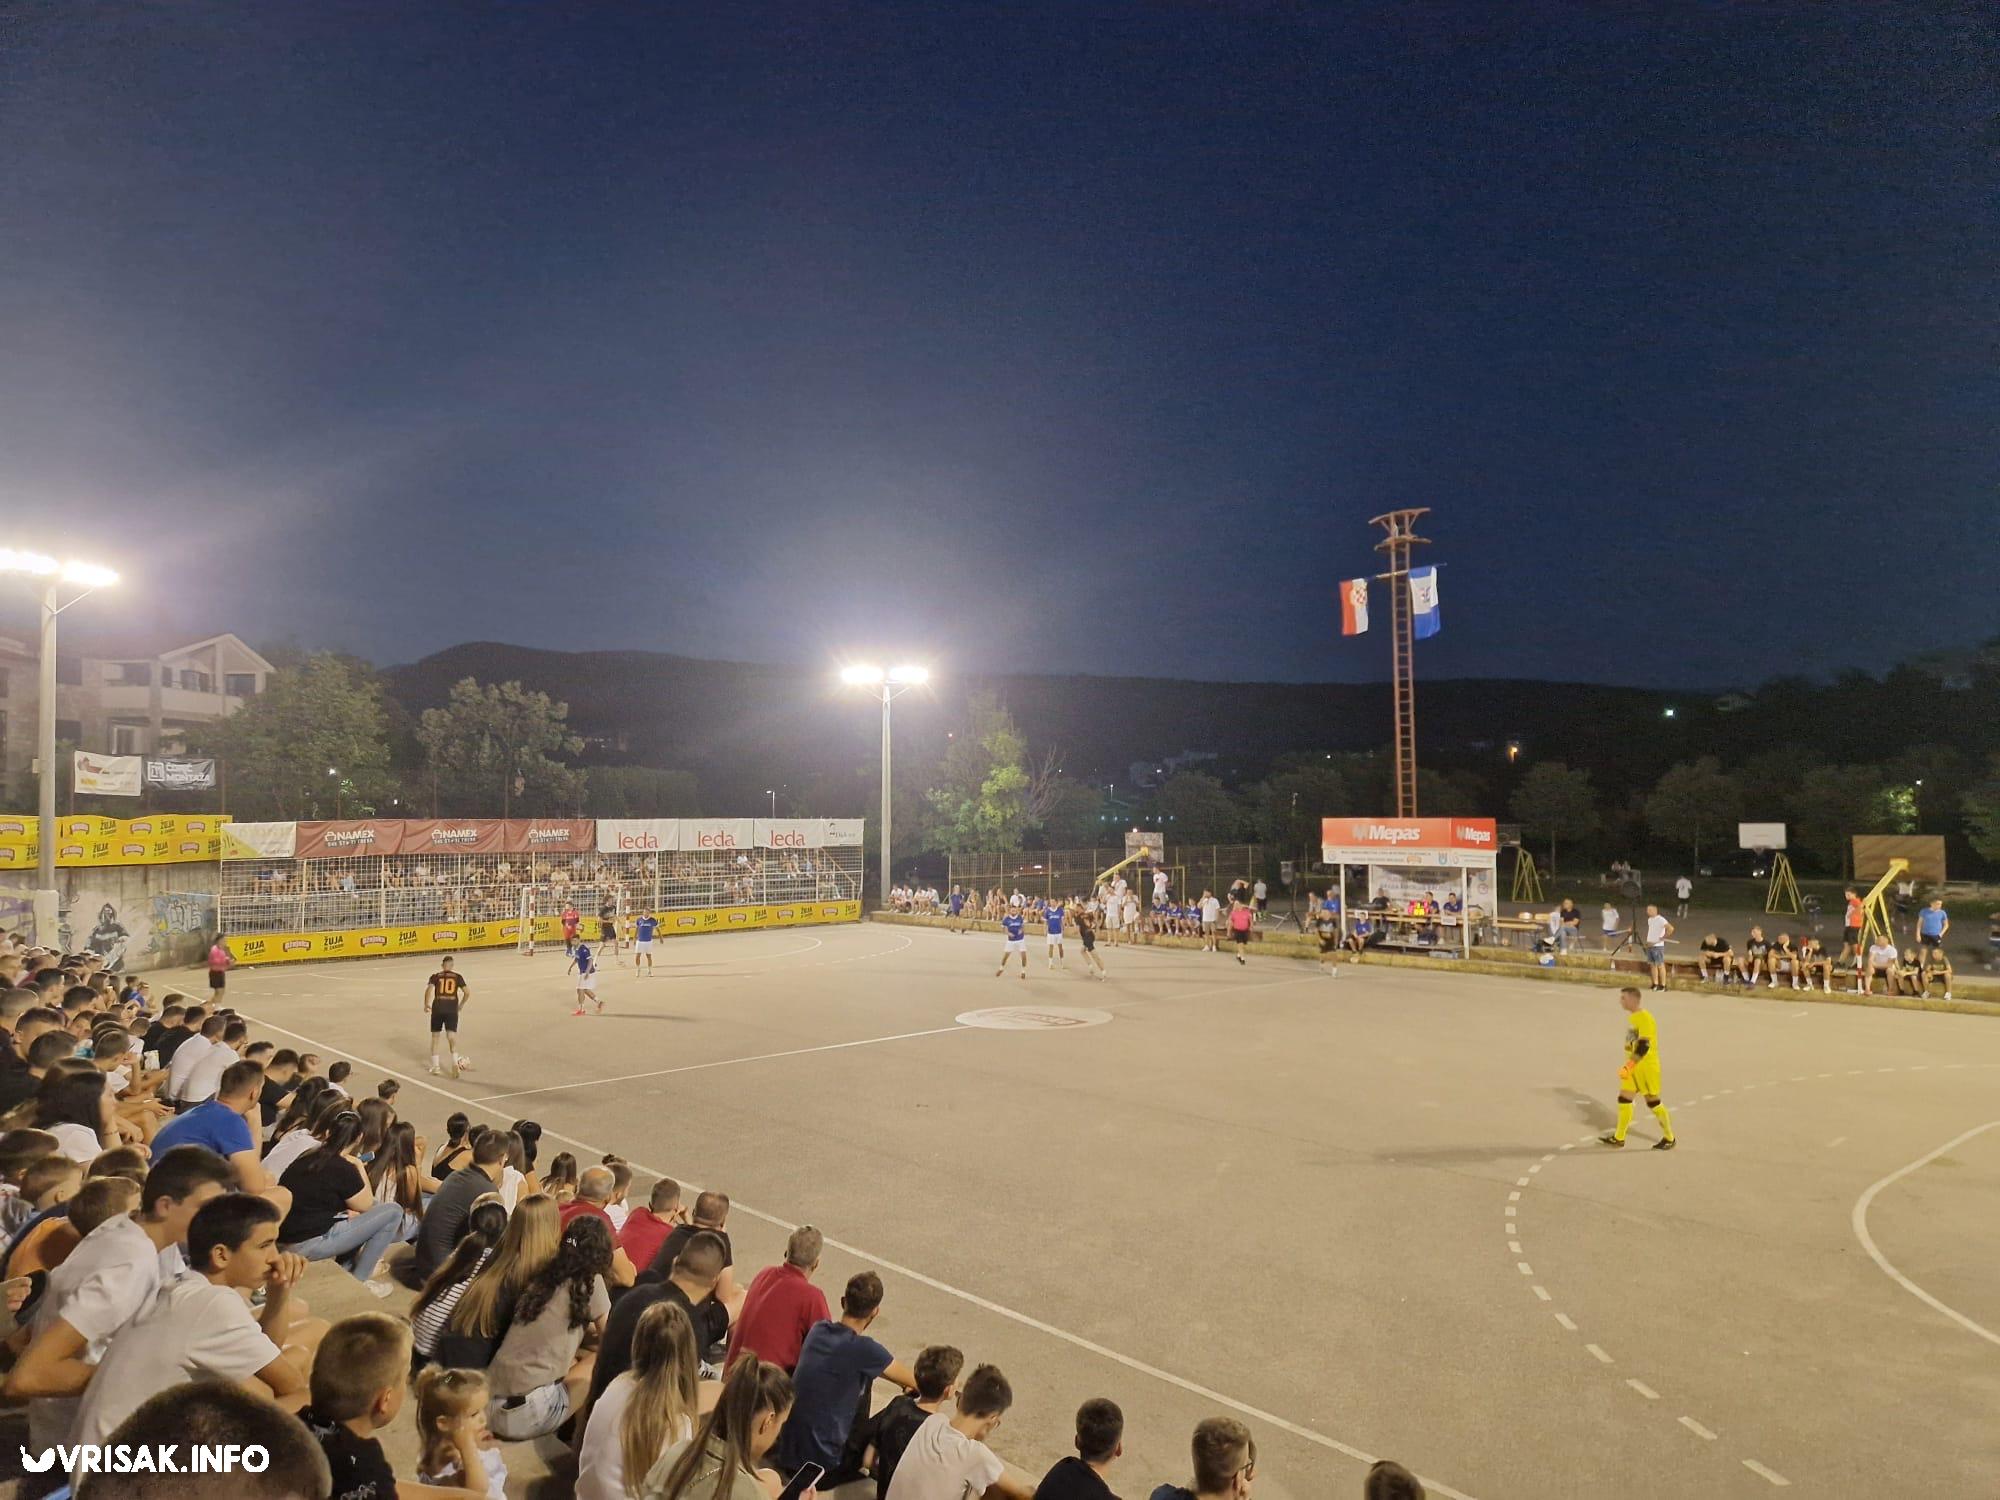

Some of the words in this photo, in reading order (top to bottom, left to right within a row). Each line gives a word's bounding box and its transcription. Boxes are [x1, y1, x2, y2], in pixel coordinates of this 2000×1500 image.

[336, 829, 375, 841] NAMEX
[442, 829, 478, 838] NAMEX
[538, 828, 570, 838] NAMEX
[698, 830, 736, 847] leda
[770, 829, 806, 847] leda
[1368, 825, 1420, 844] Mepas
[1464, 826, 1491, 844] Mepas
[618, 831, 659, 849] leda
[26, 843, 40, 857] ŽUJ
[399, 930, 417, 941] ŽUJA
[468, 926, 486, 936] ŽUJA
[244, 940, 265, 951] ŽUJA
[324, 935, 344, 946] ŽUJA
[438, 977, 456, 994] 10
